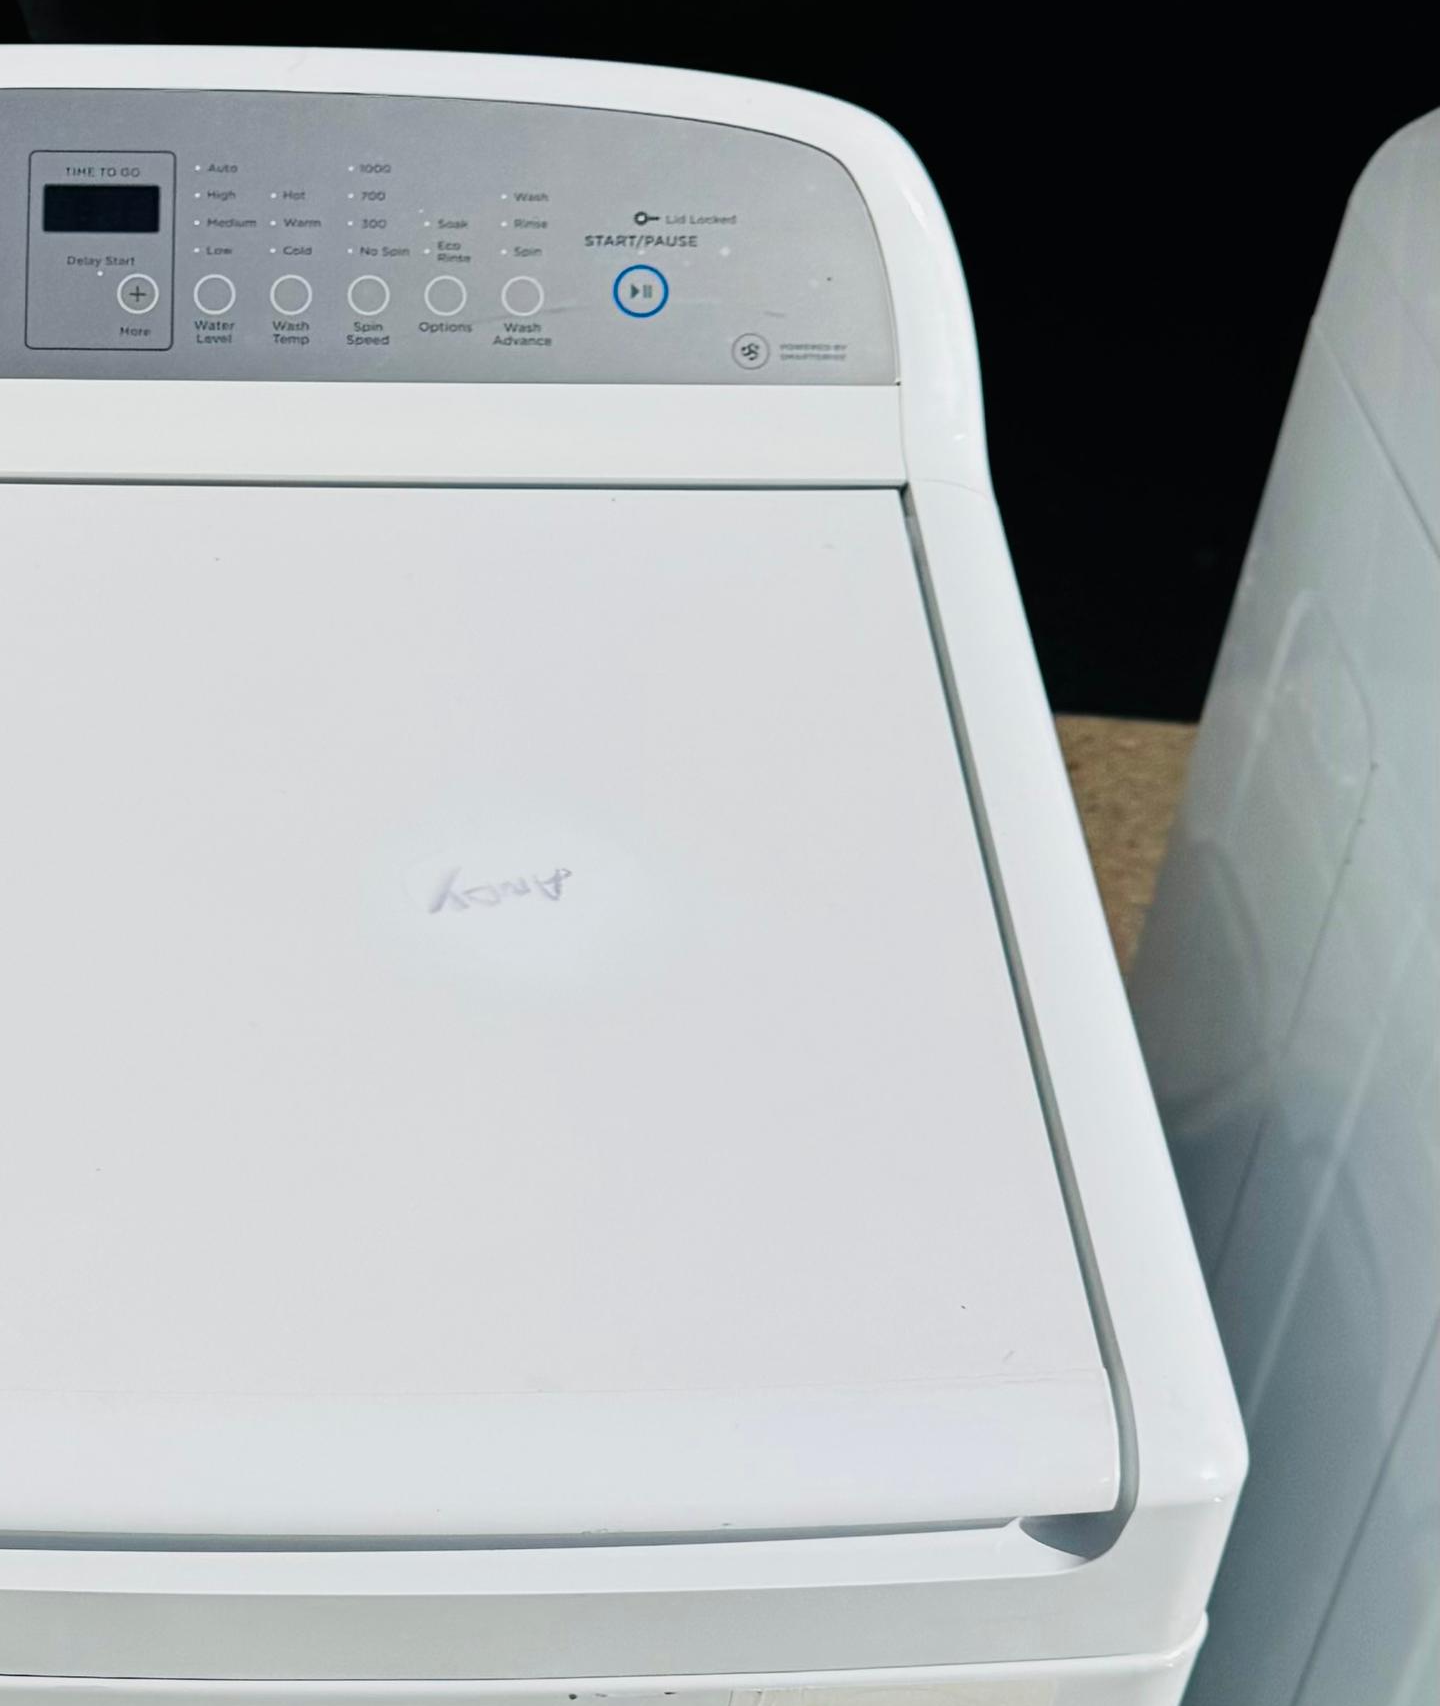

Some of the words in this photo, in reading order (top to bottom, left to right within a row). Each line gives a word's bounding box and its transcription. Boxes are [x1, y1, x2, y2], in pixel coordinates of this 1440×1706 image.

[65, 167, 95, 178] TIME
[100, 167, 117, 178] TO
[121, 167, 141, 178] GO
[207, 163, 239, 174] Auto
[360, 163, 392, 174] 1000
[207, 190, 236, 201] High
[282, 190, 306, 200] Hot
[360, 191, 386, 201] 700
[513, 191, 549, 202] Wash
[206, 218, 257, 228] Medium
[282, 218, 322, 228] Warm
[361, 218, 387, 229] 300
[437, 219, 468, 229] Soak
[513, 219, 548, 229] Rinse
[665, 214, 685, 225] Lid
[689, 214, 736, 225] Locked
[437, 241, 461, 251] Eco
[584, 235, 698, 247] START/PAUSE
[206, 245, 232, 256] Low
[282, 245, 312, 256] Cold
[360, 246, 378, 257] No
[382, 246, 410, 258] Spin
[513, 246, 543, 258] Spin
[66, 255, 101, 268] Delay
[105, 255, 135, 267] Start
[437, 253, 471, 263] Rinse
[194, 320, 236, 332] Water
[271, 320, 310, 331] Wash
[353, 321, 383, 334] Spin
[418, 321, 473, 334] Options
[503, 322, 541, 333] Wash
[119, 326, 151, 338] More
[196, 333, 232, 345] Level
[271, 334, 310, 346] Temp
[346, 334, 390, 347] Speed
[492, 335, 553, 346] Advance
